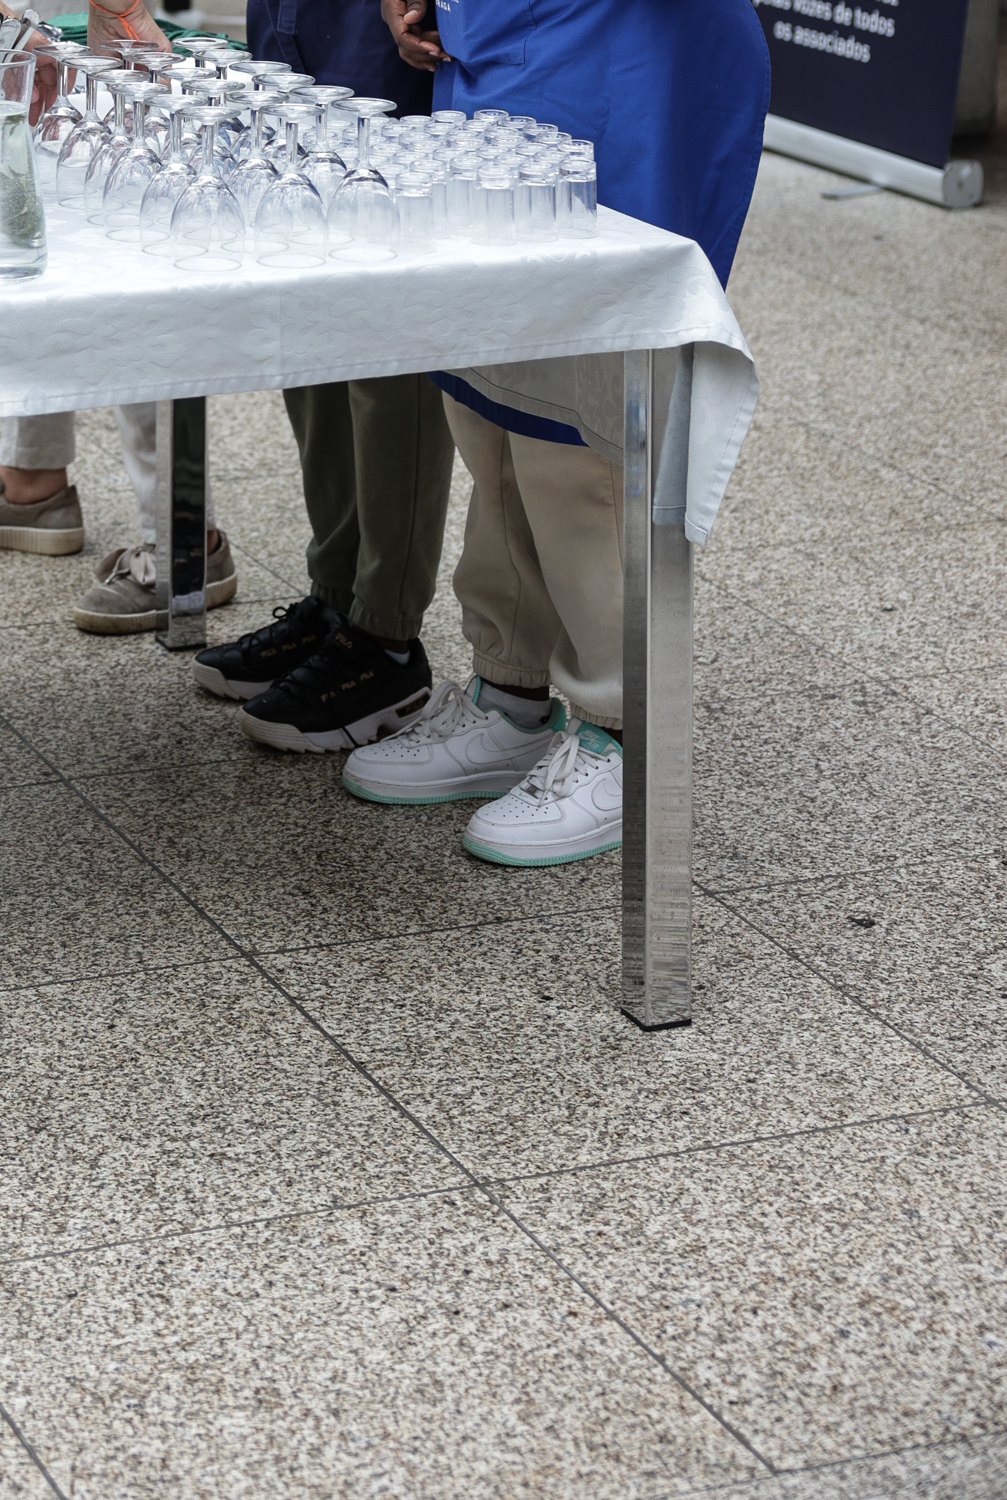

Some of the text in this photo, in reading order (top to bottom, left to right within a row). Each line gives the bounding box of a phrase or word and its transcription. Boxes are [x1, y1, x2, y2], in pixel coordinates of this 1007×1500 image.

[833, 0, 853, 26] de
[853, 5, 896, 38] todos
[773, 20, 871, 63] os associados
[335, 633, 353, 649] FILA
